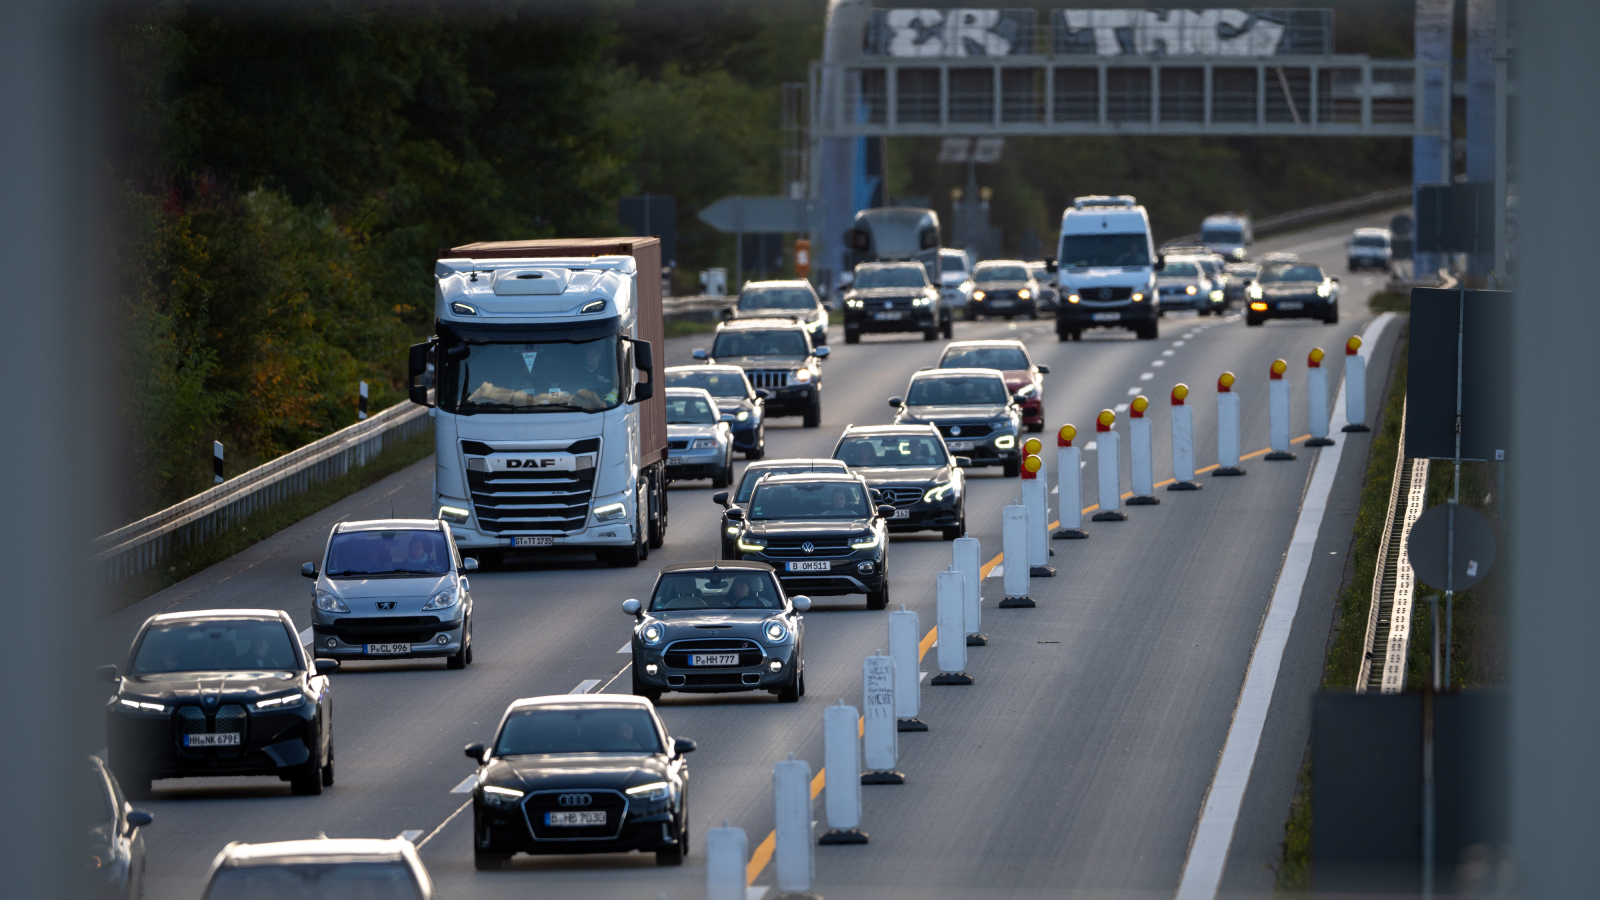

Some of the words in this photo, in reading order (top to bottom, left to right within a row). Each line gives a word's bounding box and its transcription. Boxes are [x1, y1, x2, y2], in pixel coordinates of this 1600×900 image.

[506, 459, 556, 469] DAF
[527, 537, 536, 545] TT
[536, 537, 552, 545] 1735
[792, 561, 798, 570] B
[802, 561, 812, 570] OM
[813, 561, 828, 570] 511
[370, 645, 376, 653] P
[380, 644, 391, 654] CL
[392, 644, 408, 652] 996
[695, 654, 702, 664] P
[706, 654, 718, 664] HH
[719, 654, 735, 664] 777
[189, 736, 201, 744] HH
[204, 734, 216, 744] NK
[218, 734, 239, 744] 679E
